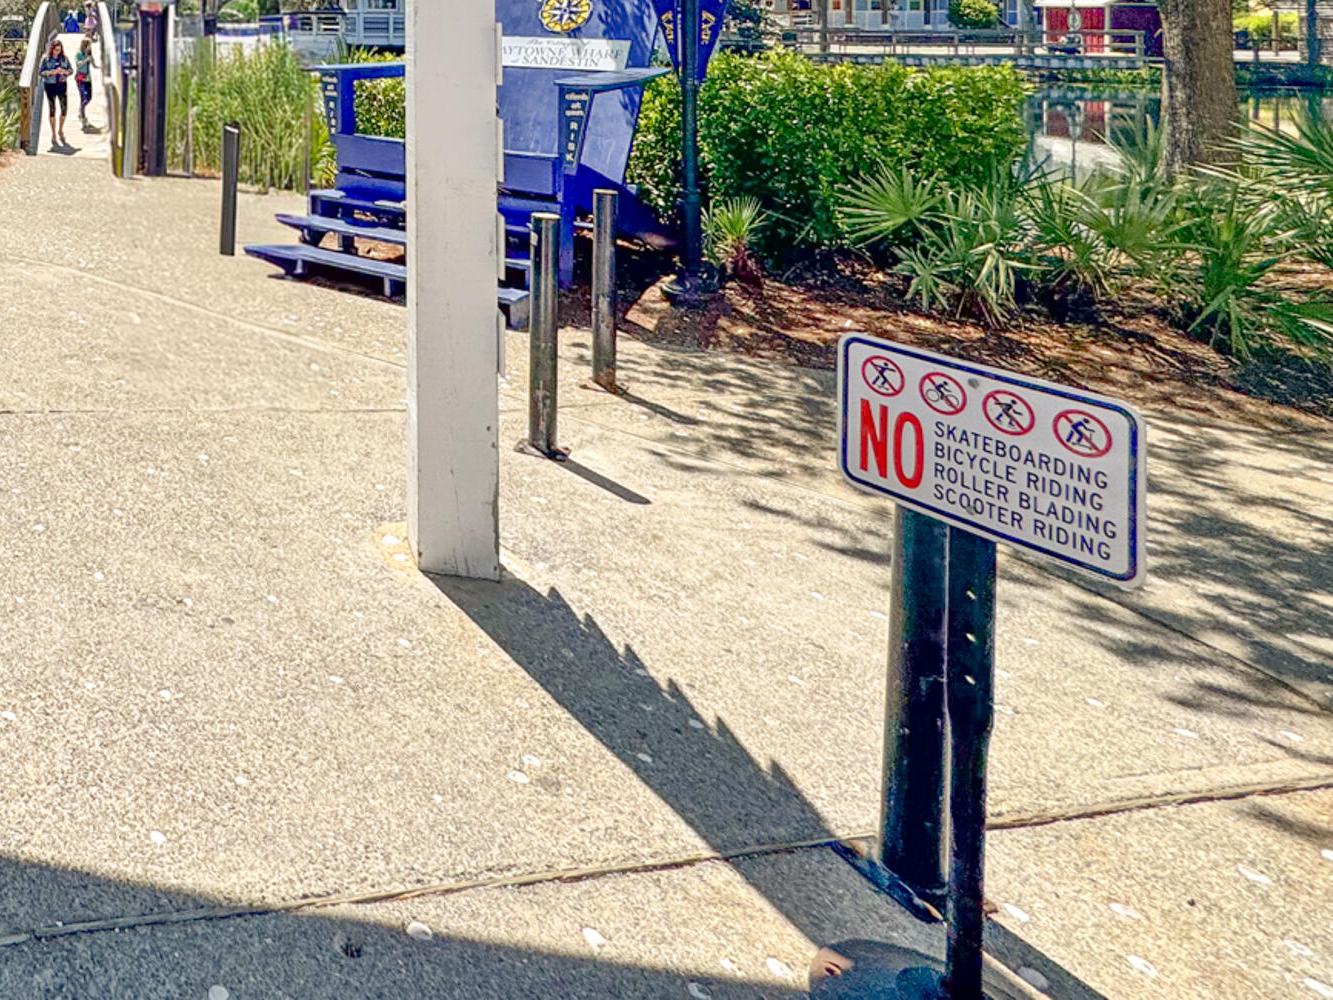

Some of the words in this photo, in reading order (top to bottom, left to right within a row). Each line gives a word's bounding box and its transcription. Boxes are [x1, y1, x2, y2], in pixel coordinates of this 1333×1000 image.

[501, 45, 565, 57] AYTOWNE
[521, 55, 600, 67] SANDESTIN
[859, 398, 924, 489] NO
[934, 421, 1109, 489] SKATEBOARDING
[934, 443, 1017, 483] BICYCLE
[1027, 473, 1104, 511] RIDING
[933, 483, 1024, 530] SCOOTER
[1033, 520, 1111, 561] RIDING
[934, 463, 1009, 503] ROLLER
[1019, 492, 1117, 539] BLADING
